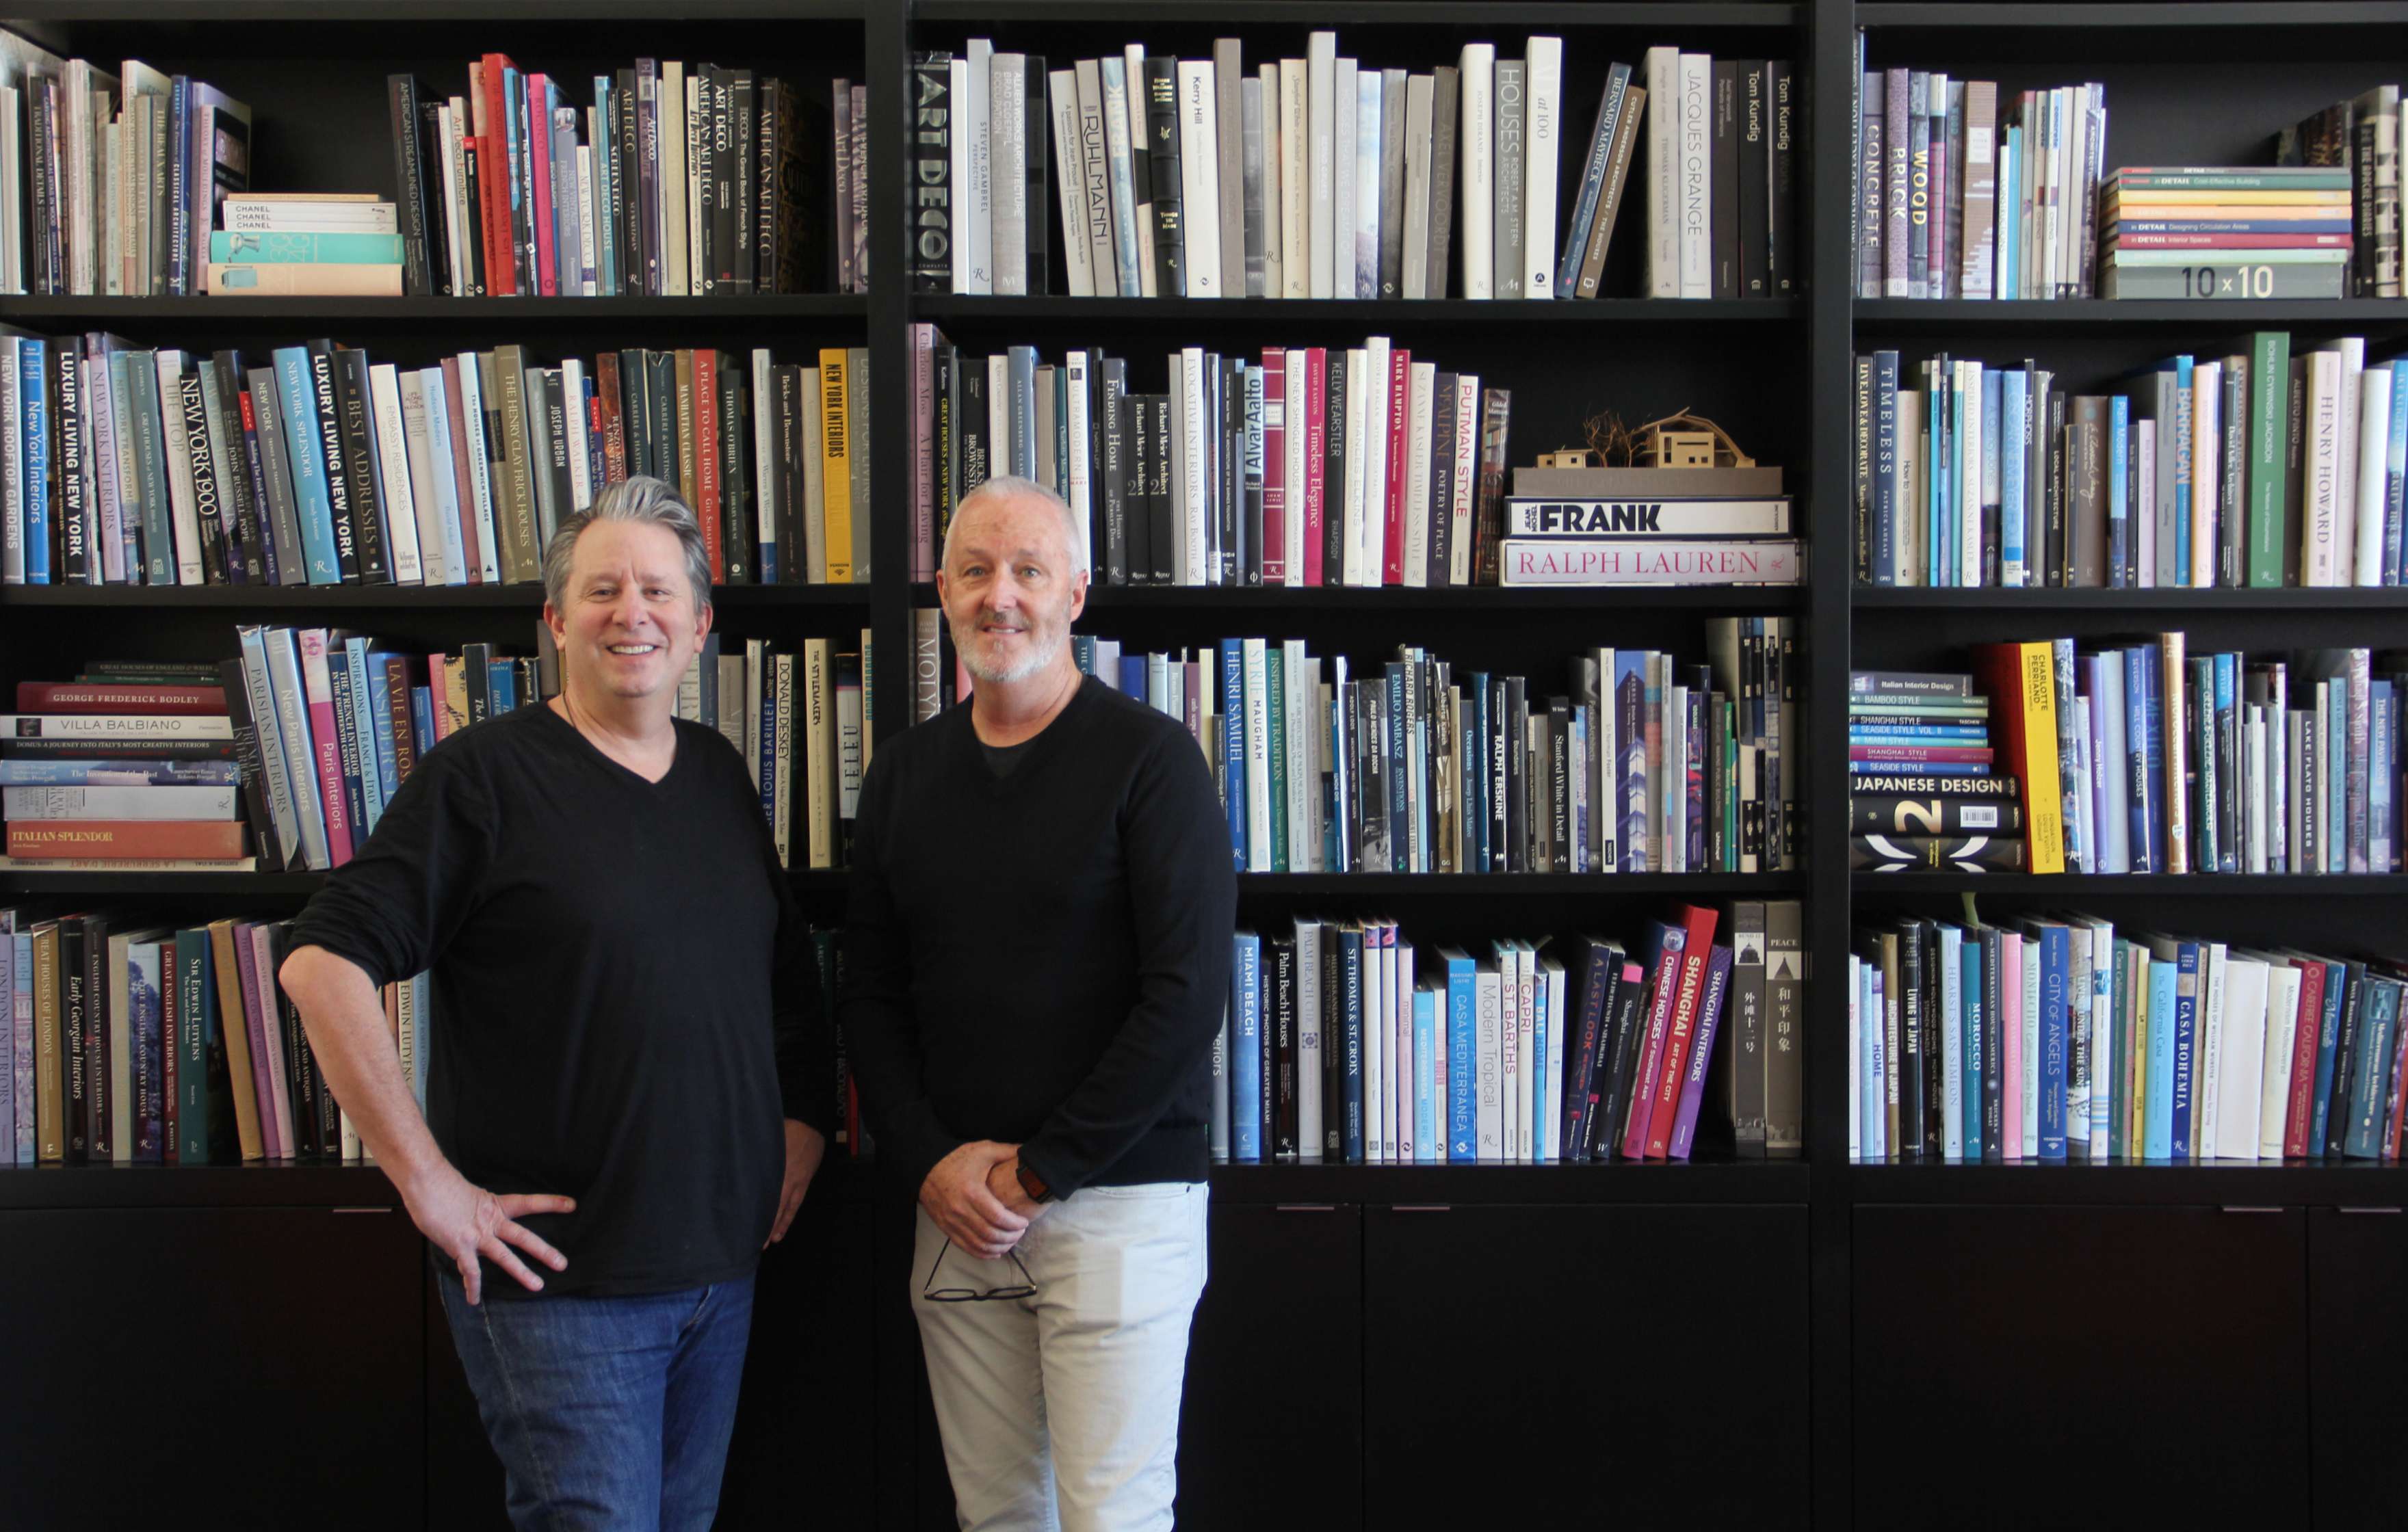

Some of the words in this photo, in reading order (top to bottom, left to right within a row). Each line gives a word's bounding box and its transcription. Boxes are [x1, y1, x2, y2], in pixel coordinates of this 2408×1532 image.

[400, 82, 411, 133] AMERICAN
[917, 72, 947, 147] ART
[1192, 77, 1201, 105] Kerry
[1500, 68, 1519, 153] HOUSES
[1537, 98, 1549, 111] at
[1603, 77, 1623, 129] BERNARD
[1687, 70, 1701, 151] JACQUES
[1779, 77, 1790, 103] Tom
[454, 116, 462, 131] Art
[1194, 108, 1202, 124] Hill
[1536, 114, 1549, 138] 100
[1777, 107, 1790, 150] Kundig
[454, 134, 463, 159] Deco
[1589, 131, 1609, 183] MAYBECK
[404, 135, 418, 200] STREAMLINED
[456, 163, 467, 205] Furniture
[601, 163, 609, 183] ART
[1084, 116, 1107, 238] RUHLMANN
[1501, 157, 1509, 214] ARCHITECTS
[1510, 157, 1518, 192] ROBERT
[1864, 125, 1879, 248] CONCRETE
[1891, 148, 1905, 220] BRICK
[1912, 150, 1927, 225] WOOD
[601, 185, 610, 214] DECO
[917, 159, 948, 259] DECO
[1687, 157, 1702, 236] GRANGE
[410, 200, 421, 236] DESIGN
[602, 216, 612, 251] HOUSE
[740, 208, 748, 230] French
[1510, 217, 1518, 247] STERN
[739, 232, 748, 249] Style
[2182, 267, 2215, 298] 10
[2238, 265, 2273, 298] 10
[700, 360, 708, 370] A
[826, 364, 841, 383] NEW
[918, 332, 932, 384] Charlotte
[1331, 362, 1342, 391] KELLY
[60, 352, 77, 412] LUXURY
[180, 378, 200, 422] NEW
[700, 372, 710, 406] PLACE
[826, 385, 843, 408] YORK
[919, 388, 930, 416] Moss
[28, 401, 40, 432] New
[347, 399, 365, 440] BEST
[701, 409, 710, 424] TO
[828, 411, 844, 458] INTERIORS
[1330, 394, 1342, 457] WEARSTLER
[1458, 384, 1472, 459] PUTMAN
[1880, 367, 1893, 474] TIMELESS
[2177, 388, 2192, 484] BARRAGAN
[2319, 397, 2333, 459] HENRY
[29, 434, 42, 463] York
[64, 418, 78, 468] LIVING
[187, 425, 209, 475] YORK
[702, 427, 711, 454] CALL
[920, 433, 931, 443] A
[1310, 422, 1322, 474] Timeless
[703, 458, 712, 491] HOME
[920, 448, 931, 479] Flair
[29, 466, 44, 524] Interiors
[66, 474, 81, 510] NEW
[194, 477, 217, 516] 1900
[354, 447, 378, 544] ADDRESSES
[919, 481, 932, 501] for
[1307, 477, 1321, 528] Elegance
[1456, 466, 1469, 518] STYLE
[2316, 465, 2331, 544] HOWARD
[68, 514, 83, 556] YORK
[919, 503, 932, 544] Living
[1539, 504, 1662, 533] FRANK
[1518, 552, 1621, 574] RALPH
[1636, 552, 1759, 574] LAUREN
[778, 663, 789, 715] DONALD
[1227, 650, 1242, 699] HENRI
[2032, 655, 2041, 704] PERRIAND
[2038, 655, 2048, 711] CHARLOTTE
[53, 695, 94, 704] GEORGE
[96, 695, 156, 704] FREDERICK
[159, 696, 198, 704] BODLEY
[60, 721, 102, 730] VILLA
[106, 721, 181, 730] BALBIANO
[778, 717, 789, 761] DESKEY
[1229, 703, 1242, 765] SAMUEL
[1254, 700, 1263, 761] MAUGHAM
[322, 743, 336, 773] Paris
[1494, 735, 1504, 771] RALPH
[1554, 735, 1565, 773] Stanford
[327, 777, 343, 830] Interiors
[1495, 776, 1504, 821] ERSKINE
[1556, 774, 1565, 802] White
[1855, 777, 1935, 793] JAPANESE
[1941, 779, 2003, 793] DESIGN
[1556, 804, 1565, 814] in
[1556, 815, 1565, 841] Detail
[12, 832, 58, 841] ITALIAN
[59, 832, 114, 841] SPLENDOR
[1244, 947, 1254, 987] MIAMI
[1279, 952, 1289, 978] Palm
[1658, 955, 1675, 998] CHINESE
[68, 976, 83, 1003] Early
[1279, 979, 1289, 1009] Beach
[1504, 983, 1515, 1005] ST.
[1521, 983, 1531, 1033] CAPRI
[1674, 955, 1701, 1038] SHANGHAI
[1702, 970, 1723, 1027] SHANGHAI
[2047, 973, 2061, 1003] CITY
[68, 1007, 83, 1053] Georgian
[1244, 992, 1254, 1036] BEACH
[1279, 1011, 1289, 1048] Houses
[1456, 994, 1467, 1029] CASA
[1482, 985, 1495, 1044] Modern
[1651, 999, 1667, 1040] HOUSES
[2048, 1005, 2058, 1021] OF
[2179, 1001, 2190, 1038] CASA
[1264, 1046, 1269, 1059] OF
[1505, 1010, 1516, 1074] BARTHS
[1672, 1042, 1680, 1057] ART
[1690, 1028, 1710, 1082] INTERIORS
[1972, 1003, 1981, 1071] MOROCCO
[2047, 1023, 2061, 1076] ANGELS
[72, 1056, 84, 1100] Interiors
[1456, 1031, 1467, 1132] MEDITERRANEA
[1483, 1048, 1497, 1107] Tropical
[1645, 1049, 1657, 1084] Southeast
[1667, 1068, 1677, 1085] THE
[1670, 1058, 1678, 1068] OF
[2176, 1043, 2188, 1110] BOHEMIA
[1663, 1085, 1674, 1102] CITY
